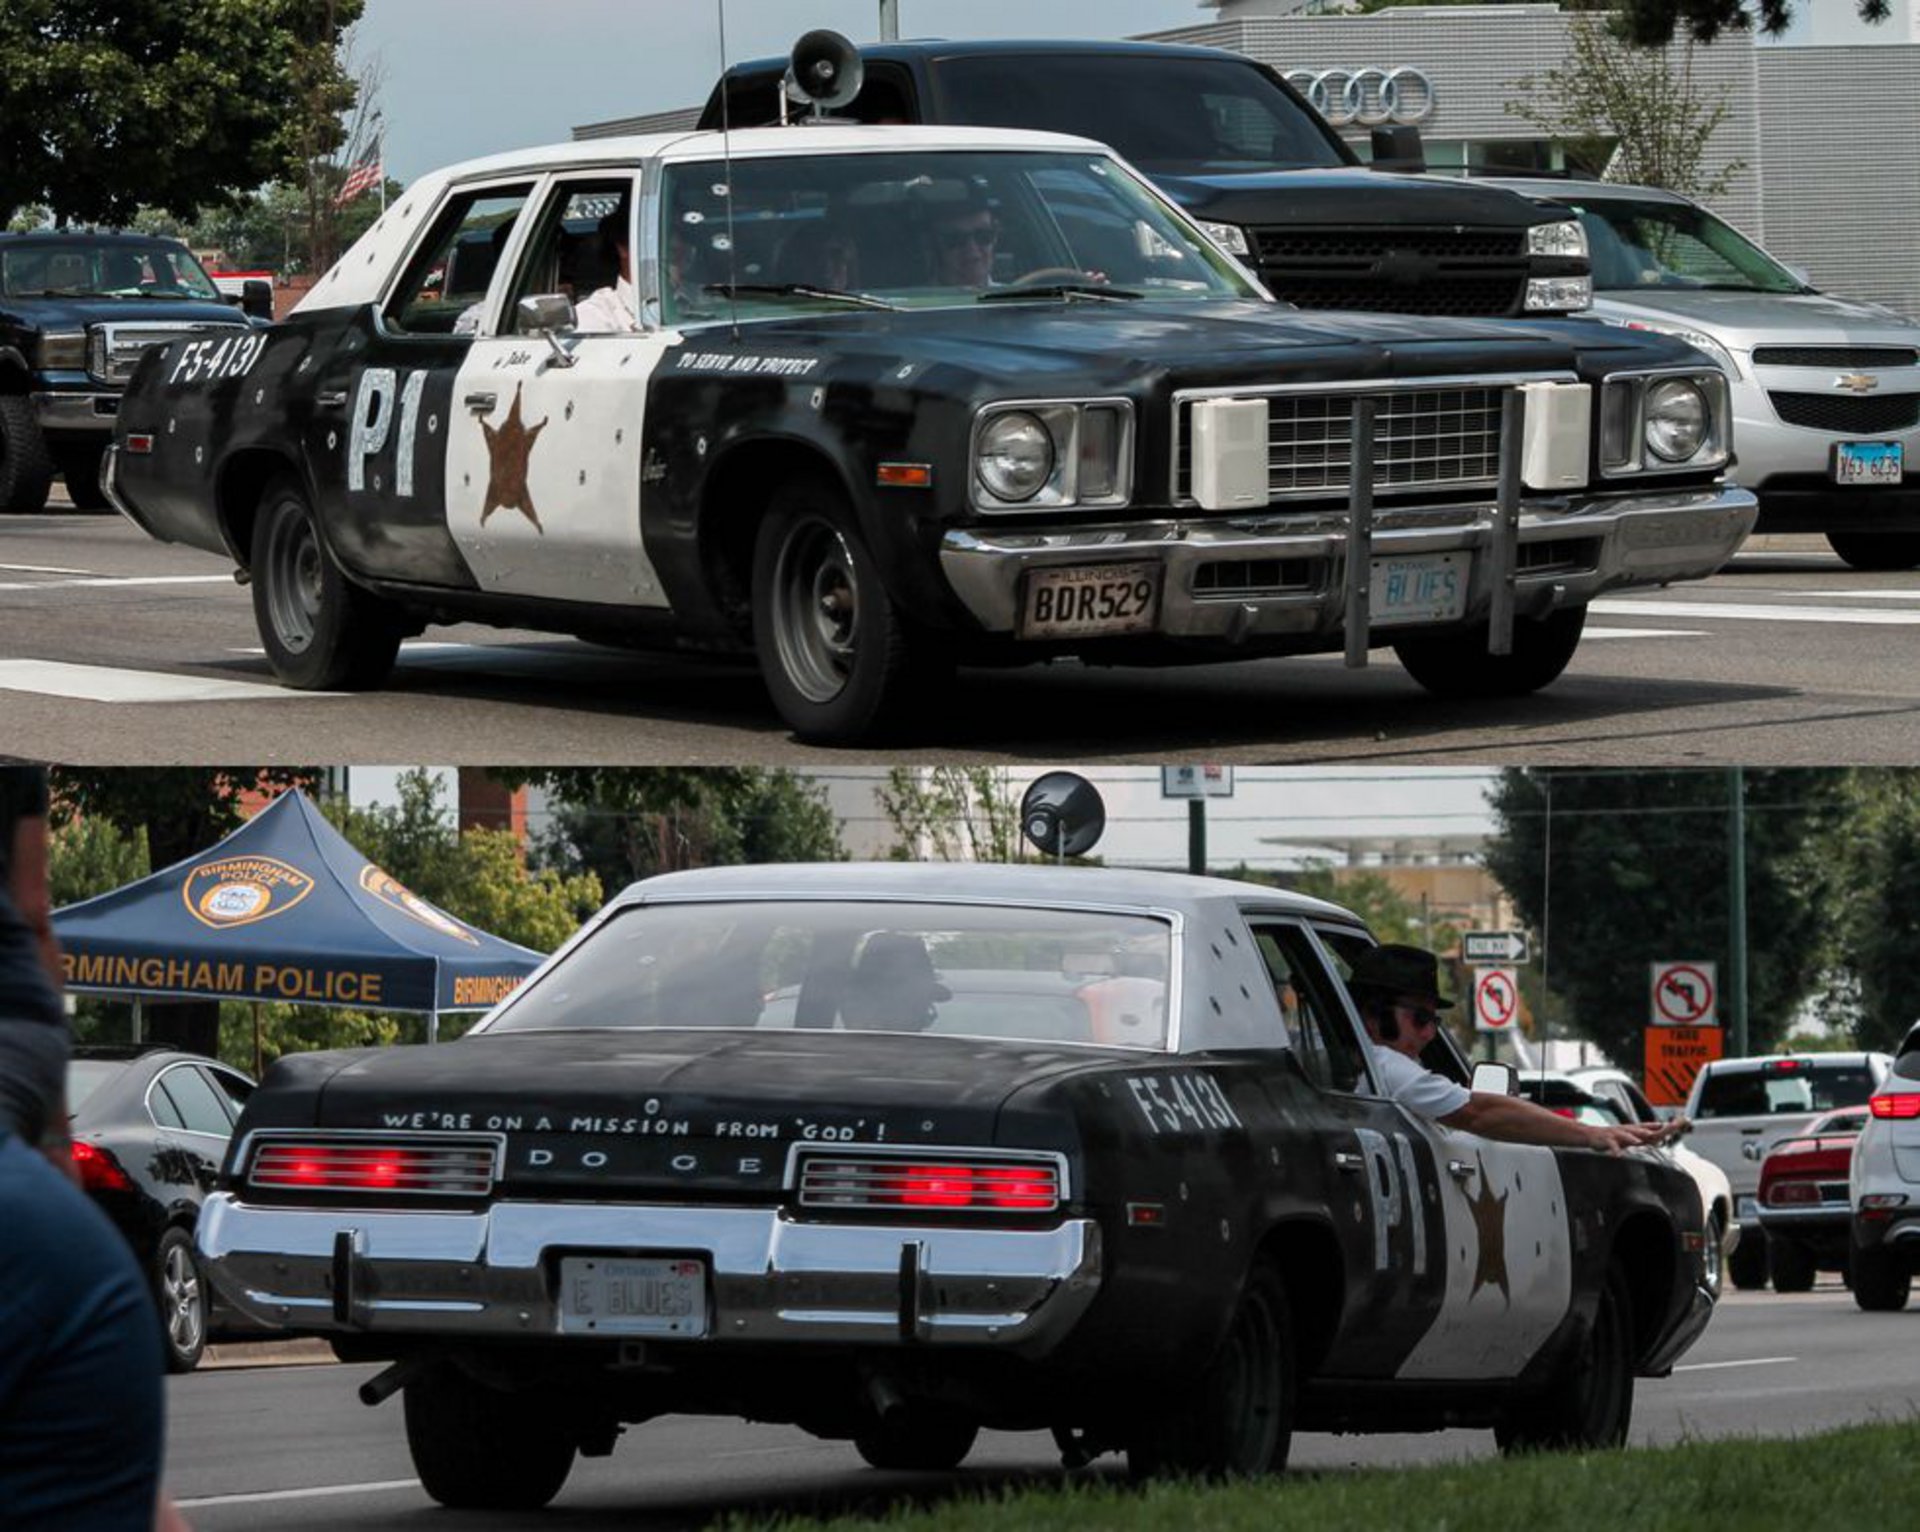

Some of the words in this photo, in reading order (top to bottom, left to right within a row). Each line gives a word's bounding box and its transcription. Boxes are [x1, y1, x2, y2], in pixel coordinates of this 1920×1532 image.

[169, 333, 268, 384] F5-4131
[348, 368, 430, 497] P1
[1035, 580, 1152, 623] BDR529
[200, 861, 303, 887] BIRMINGHAM
[220, 871, 276, 888] POLICE
[61, 953, 245, 993] RMINGHAM
[254, 965, 382, 1002] POLICE
[384, 1112, 471, 1129] WE'RE
[487, 1115, 522, 1130] ON
[536, 1116, 552, 1130] A
[571, 1117, 689, 1135] MISSION
[715, 1121, 779, 1139] FROM
[1127, 1075, 1243, 1133] F5-4131
[1354, 1127, 1427, 1275] P1
[609, 1279, 693, 1317] BLUES
